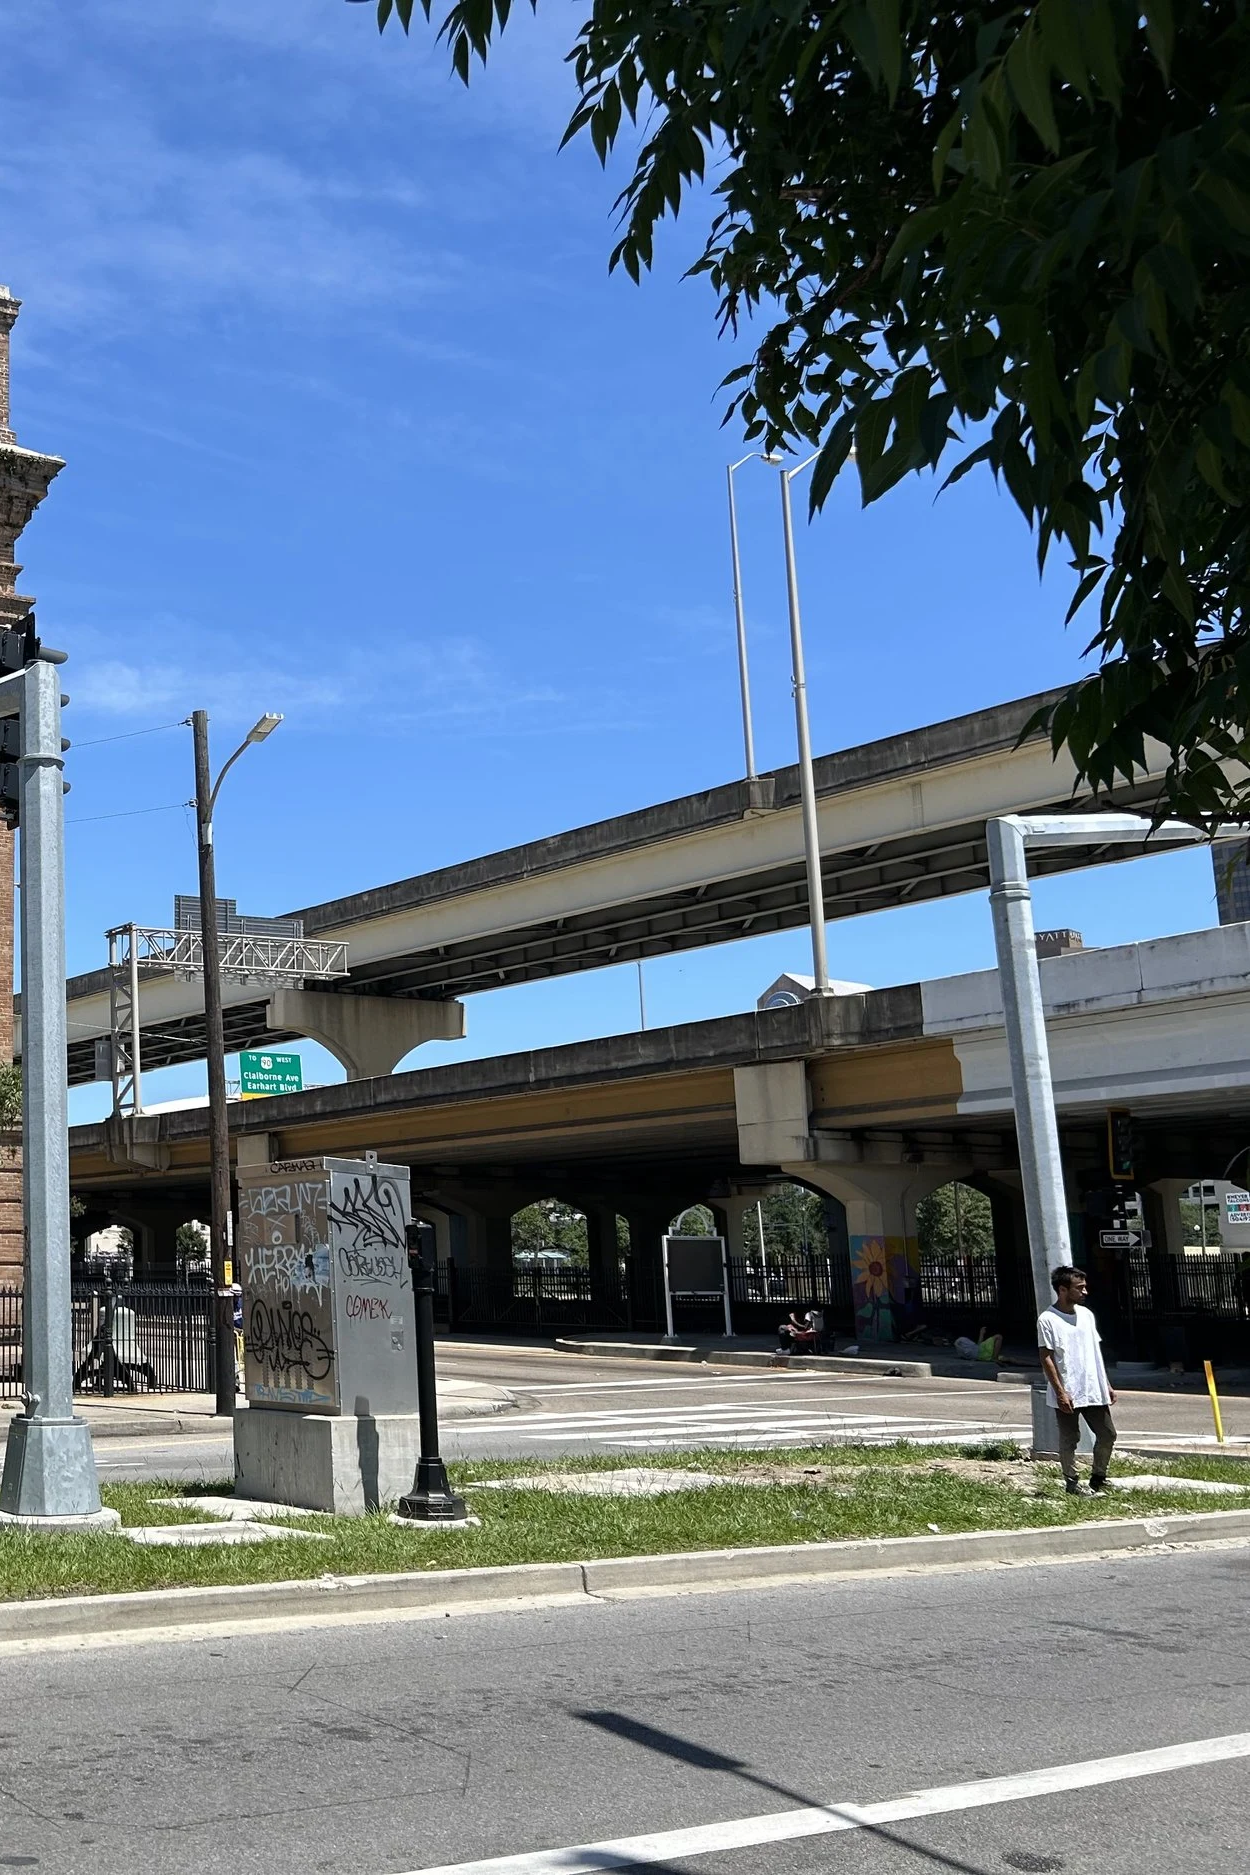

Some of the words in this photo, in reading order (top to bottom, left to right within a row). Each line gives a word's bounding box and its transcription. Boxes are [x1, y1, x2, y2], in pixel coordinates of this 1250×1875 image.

[1034, 931, 1067, 942] YATT
[243, 1072, 282, 1080] Claiborne
[285, 1074, 299, 1082] Ave
[247, 1082, 277, 1090] Earhart
[1104, 1235, 1116, 1243] ONE
[1117, 1235, 1129, 1243] WAY
